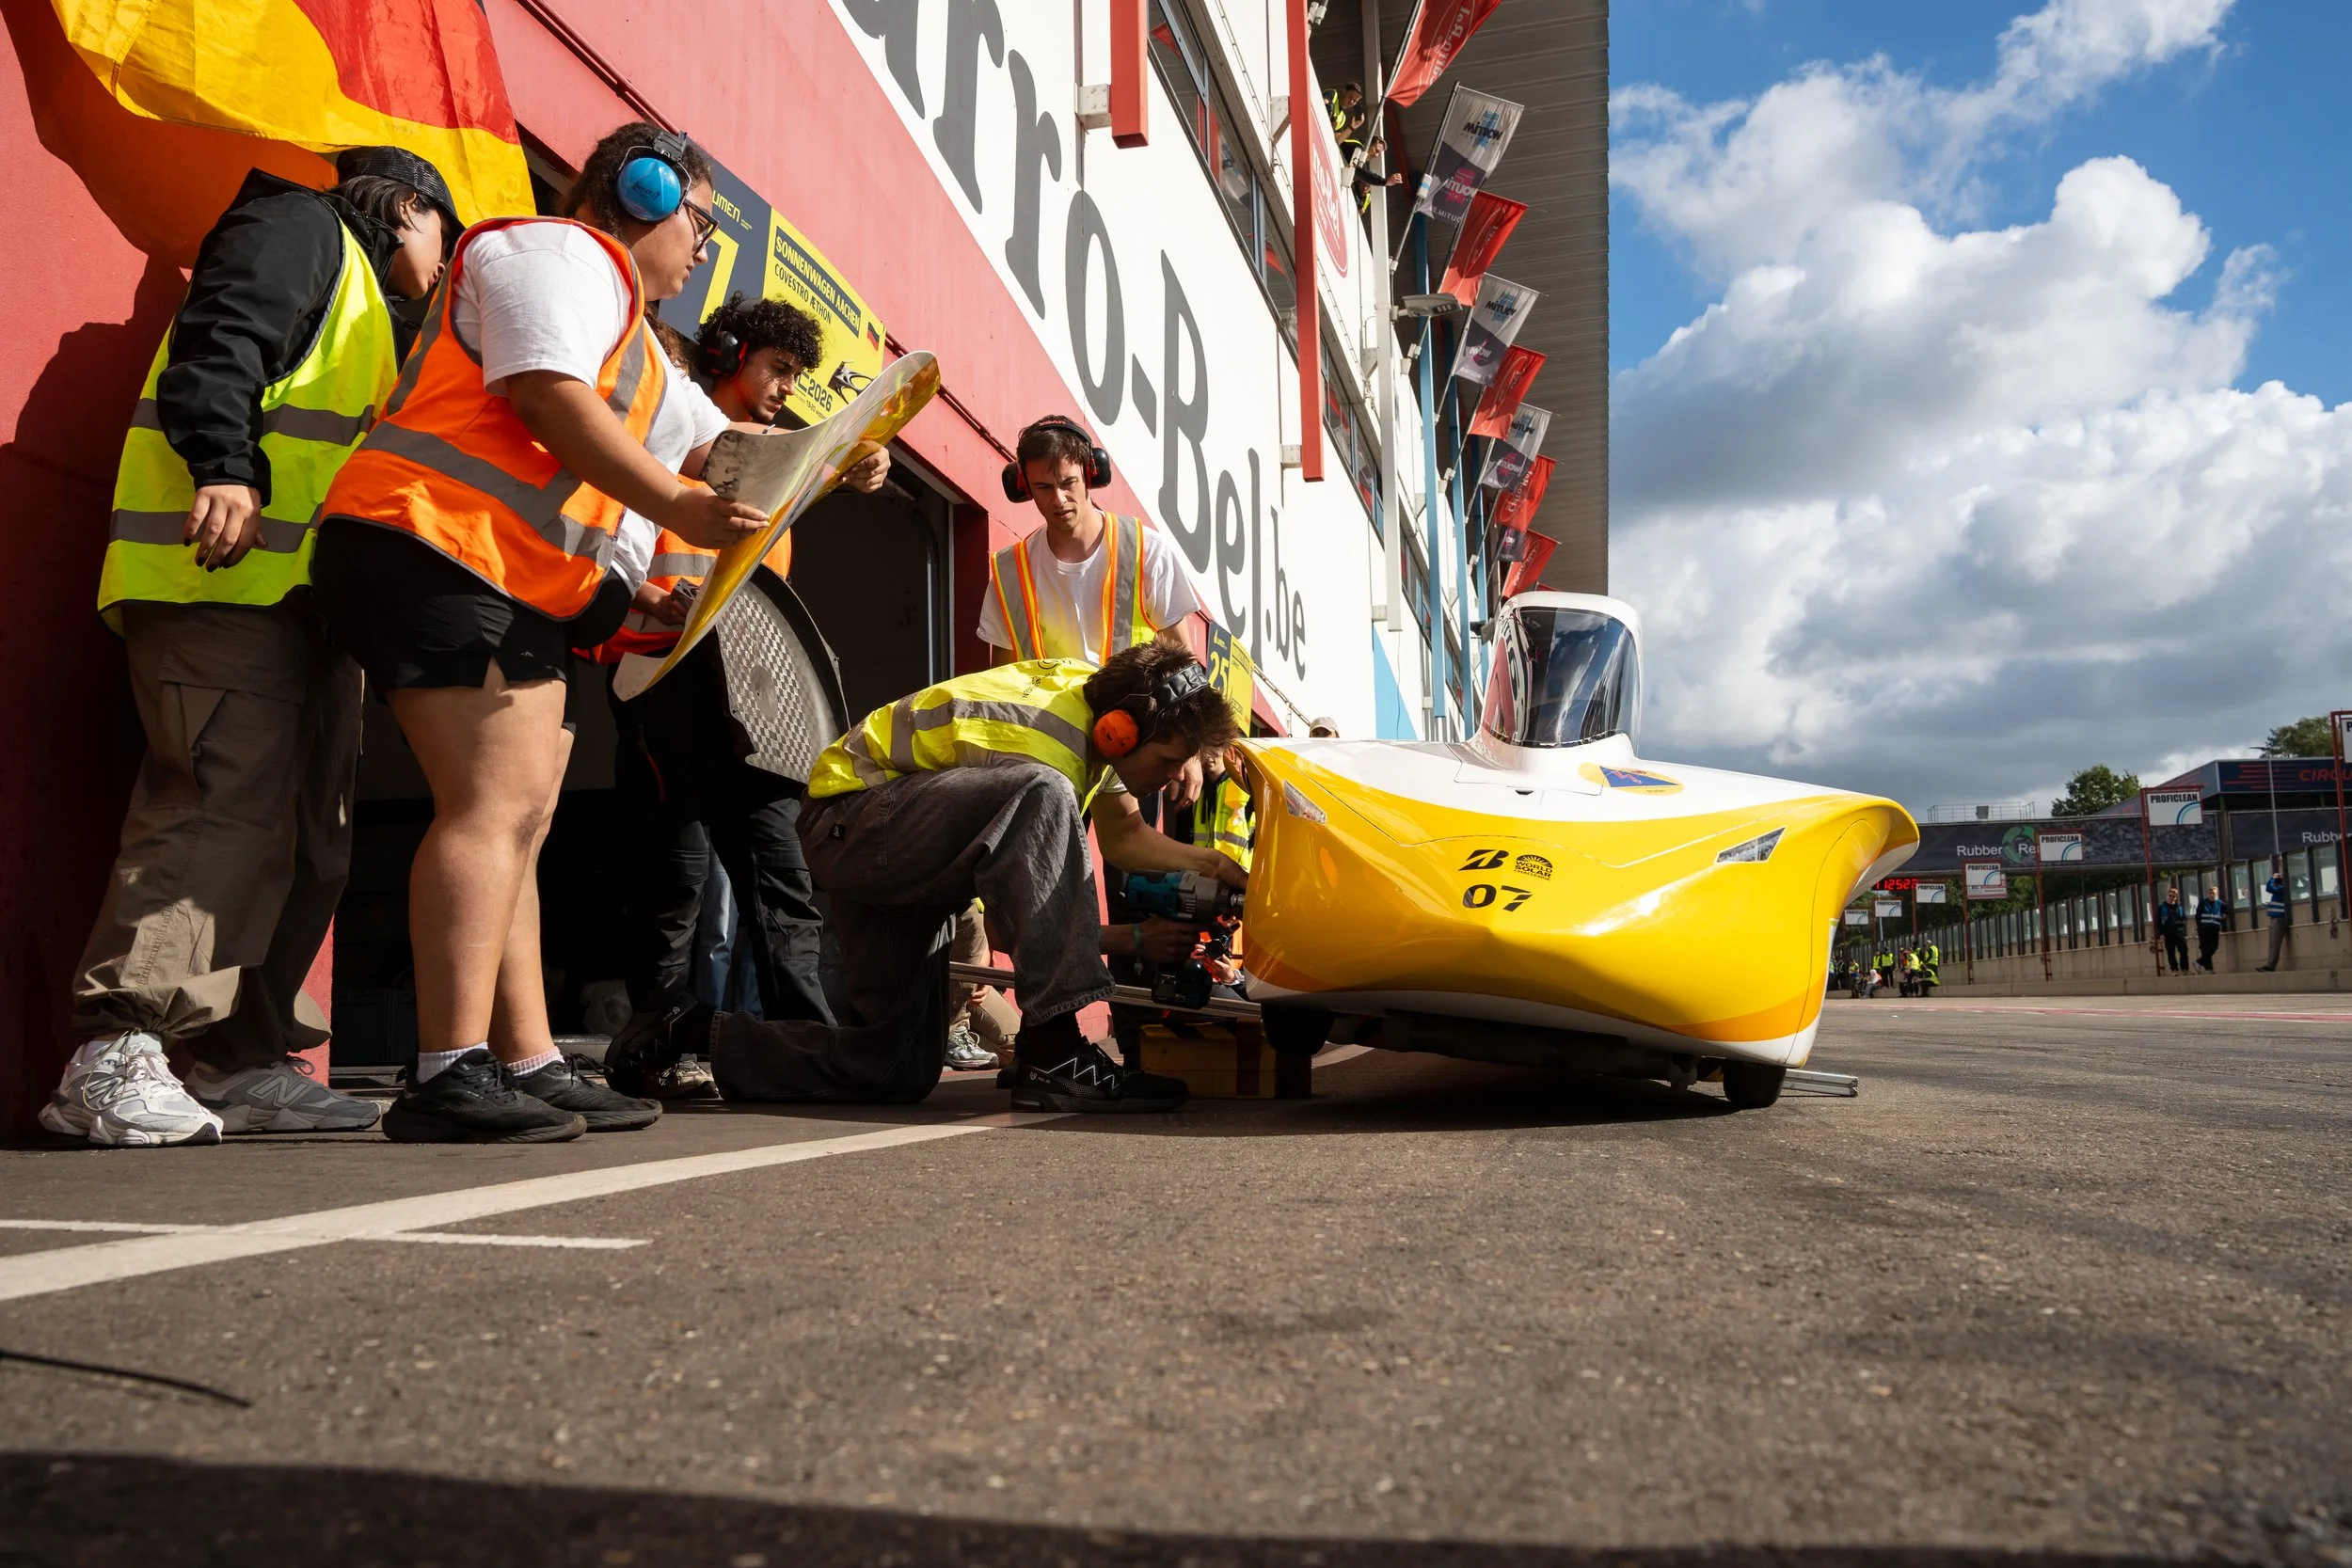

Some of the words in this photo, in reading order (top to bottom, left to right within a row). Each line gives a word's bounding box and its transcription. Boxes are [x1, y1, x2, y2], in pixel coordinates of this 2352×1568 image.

[712, 190, 741, 223] UMEN
[775, 235, 835, 304] SONNENWAGEN
[834, 293, 861, 330] AACHEN
[774, 262, 809, 303] COVESTRO
[809, 297, 832, 325] ÆTHON
[808, 378, 833, 412] 2026
[1208, 651, 1230, 700] 25
[2151, 793, 2198, 803] PROFICLEAN
[2042, 835, 2079, 844] PROFICLEAN
[1957, 845, 2003, 857] Rubber
[1514, 869, 1550, 881] CHALLENGE
[1515, 865, 1551, 878] SOLAR
[1516, 861, 1552, 873] WORLD
[1463, 884, 1534, 911] 07
